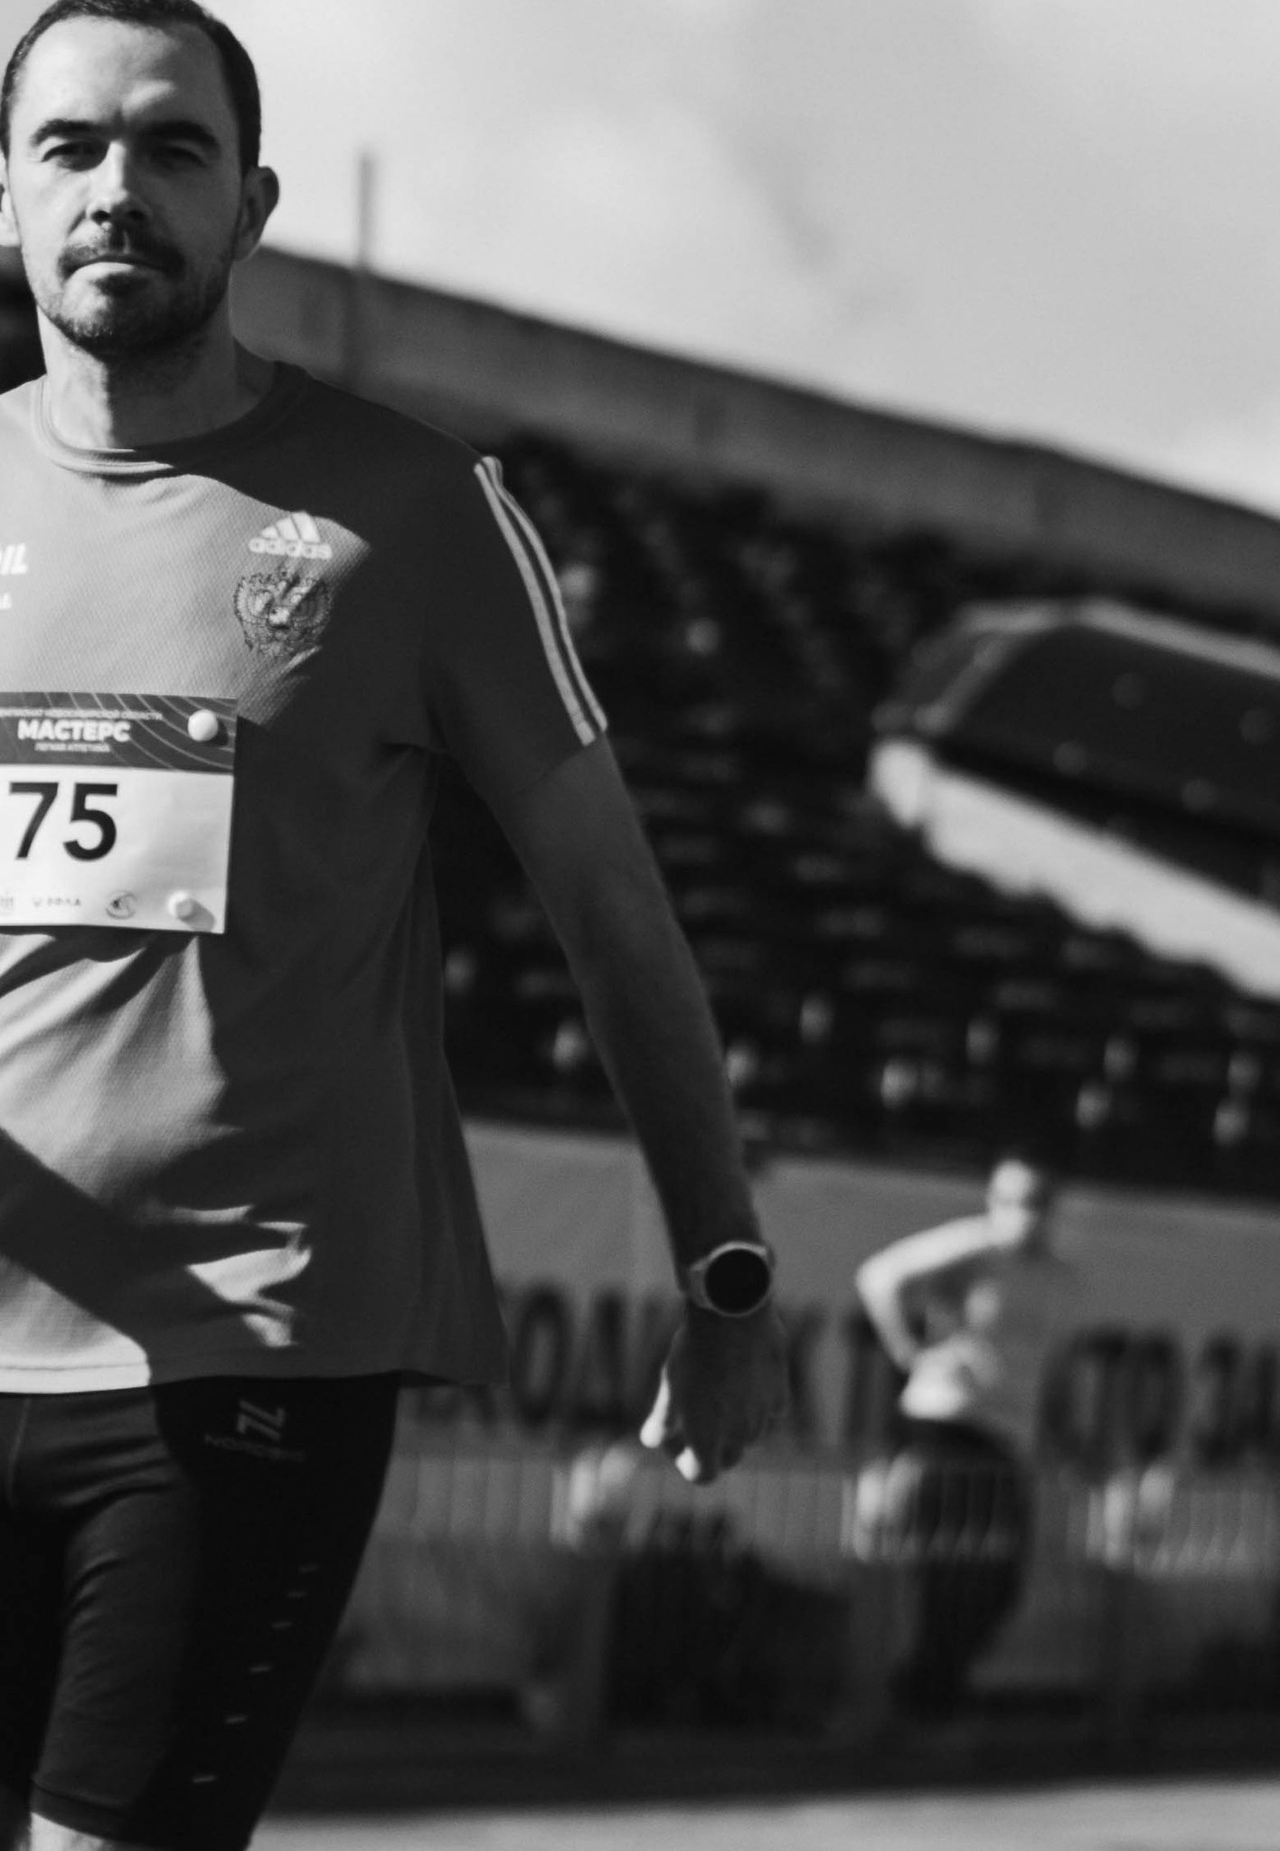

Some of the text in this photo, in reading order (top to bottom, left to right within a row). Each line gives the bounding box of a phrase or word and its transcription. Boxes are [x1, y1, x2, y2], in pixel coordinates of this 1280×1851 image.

[248, 537, 333, 560] adidas
[18, 719, 131, 743] МАСТЕРС
[9, 782, 119, 862] 75
